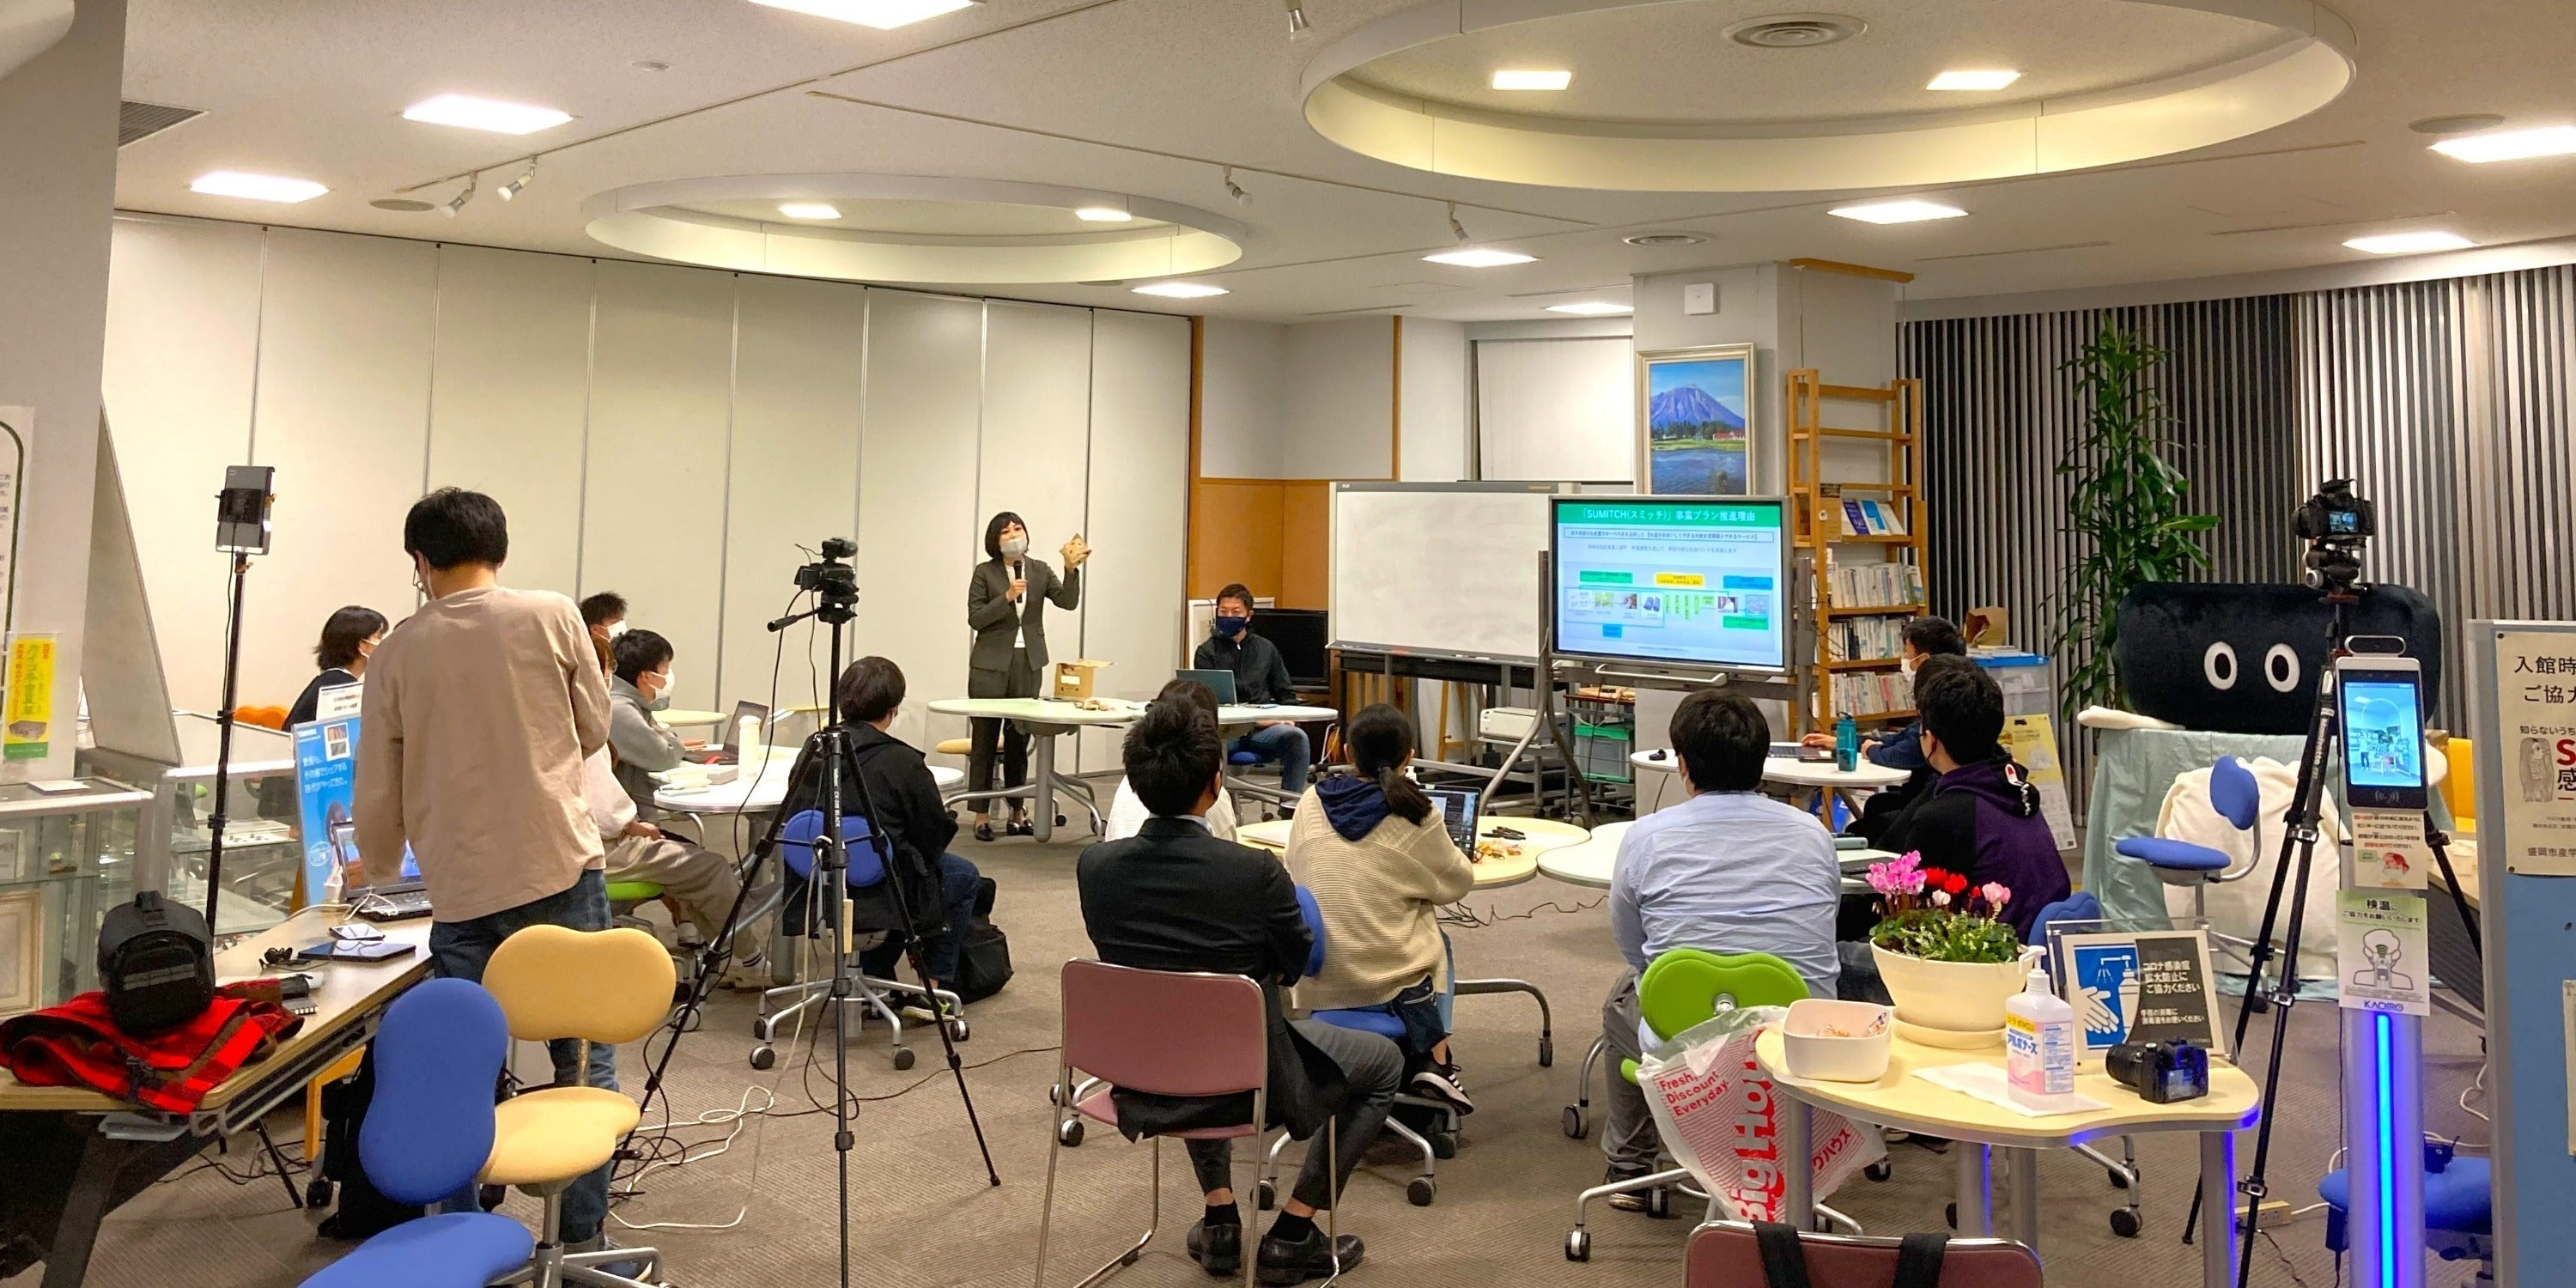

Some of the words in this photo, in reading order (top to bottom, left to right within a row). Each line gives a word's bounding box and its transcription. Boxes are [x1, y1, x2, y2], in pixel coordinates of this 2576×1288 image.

[2519, 726, 2576, 736] 知らないうち
[2143, 960, 2190, 971] コロナ感染症
[2145, 972, 2188, 983] 拡大防止に
[2147, 983, 2201, 994] ご協力ください
[2364, 1000, 2404, 1012] KAOIRO
[1659, 1072, 1698, 1091] Fresh,
